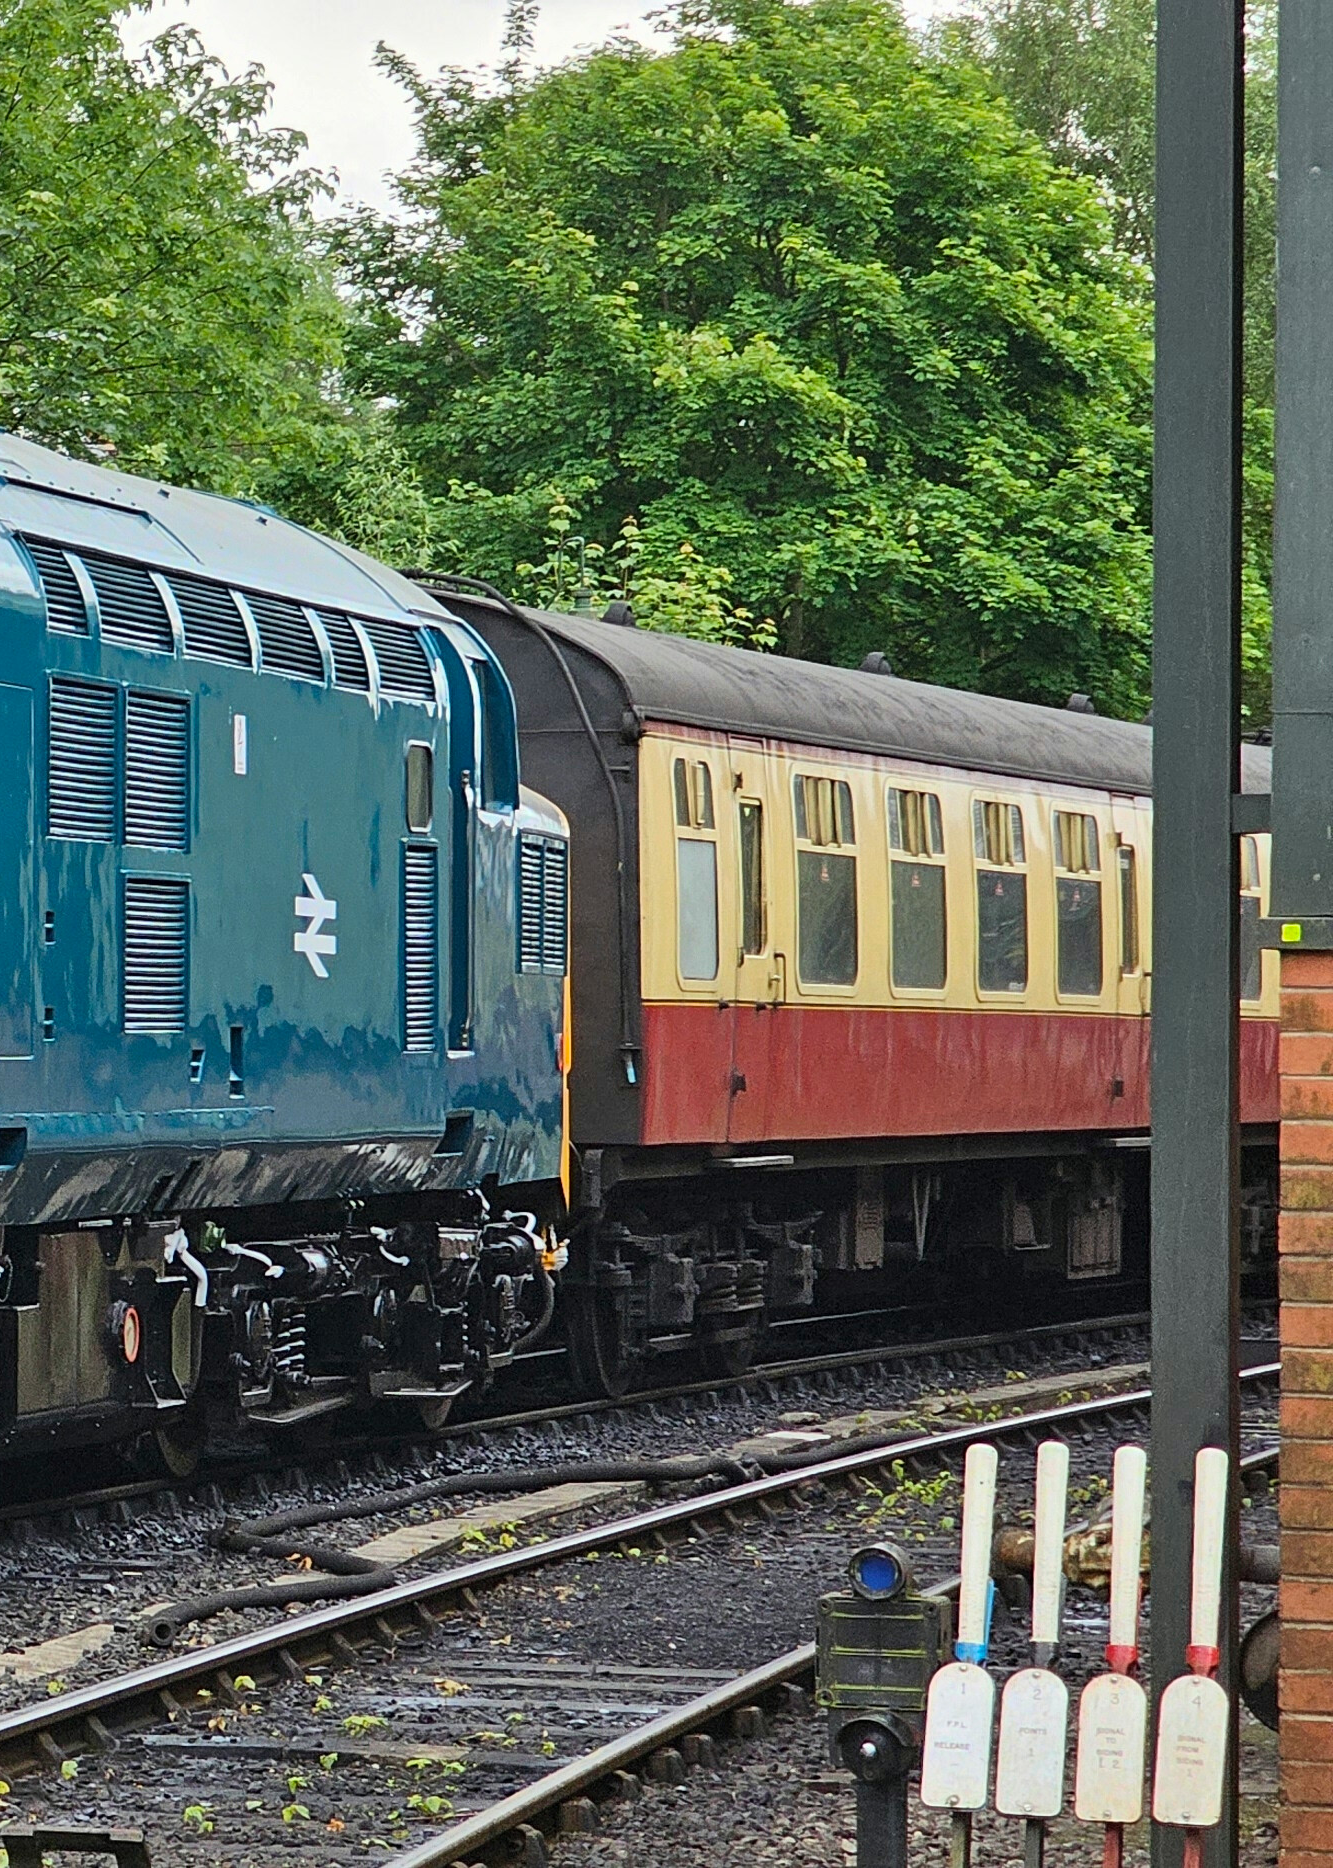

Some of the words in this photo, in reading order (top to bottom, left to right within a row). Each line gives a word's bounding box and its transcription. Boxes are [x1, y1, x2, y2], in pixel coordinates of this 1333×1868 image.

[1032, 1688, 1042, 1701] 2
[1110, 1692, 1120, 1705] 3
[1190, 1695, 1201, 1709] 4
[1018, 1726, 1048, 1736] POINTS
[933, 1740, 971, 1751] RELEASE
[1105, 1736, 1117, 1745] TO
